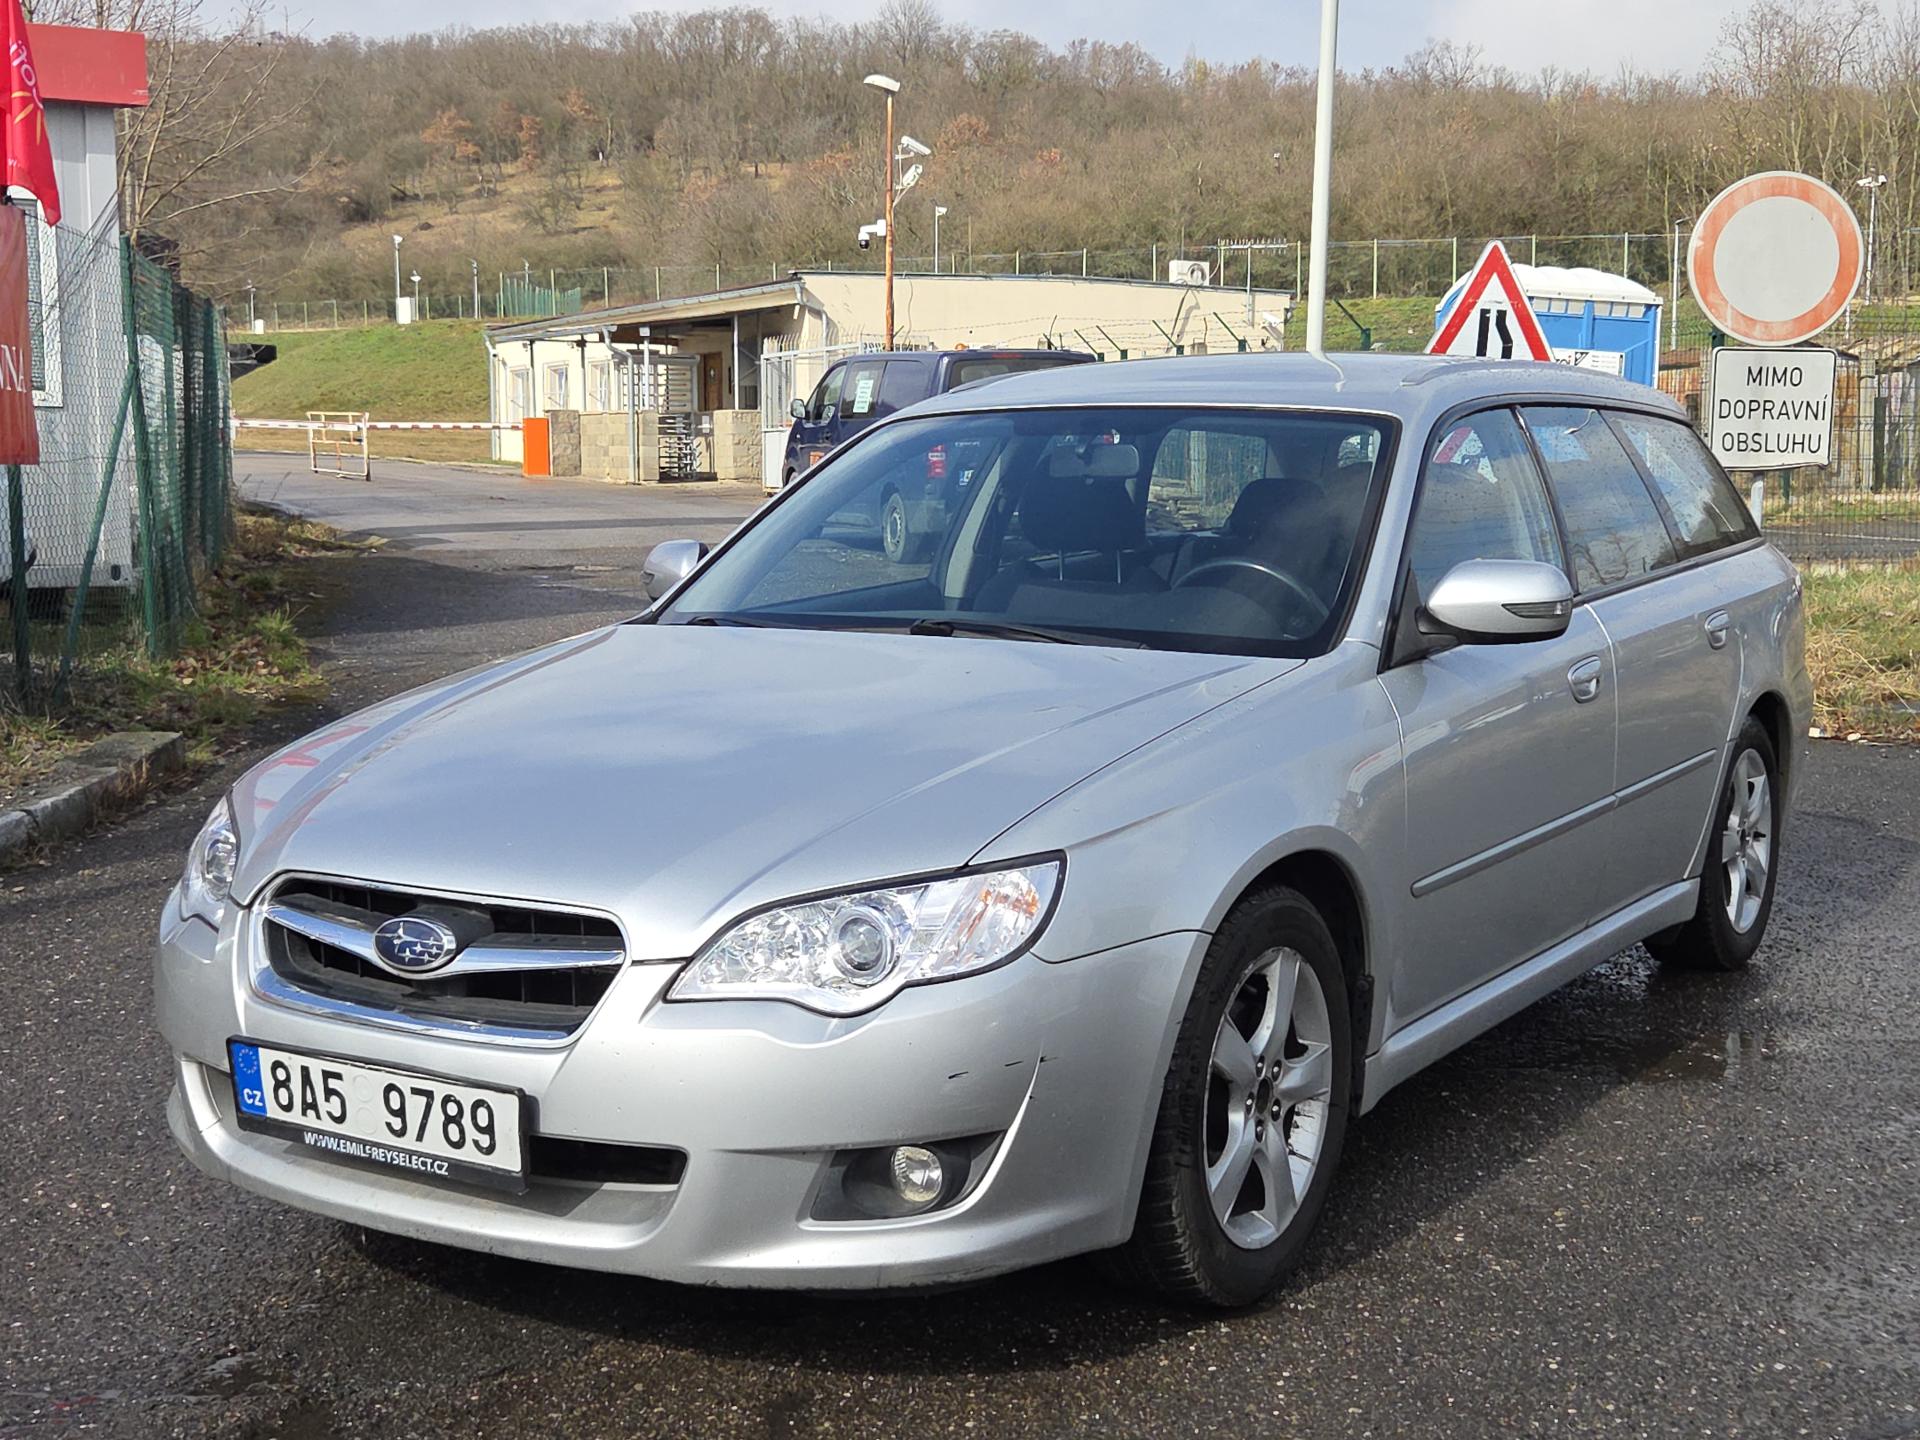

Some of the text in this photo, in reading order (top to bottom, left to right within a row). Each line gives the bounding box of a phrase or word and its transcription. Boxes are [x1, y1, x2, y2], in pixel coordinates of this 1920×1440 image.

[1746, 366, 1803, 387] MIMO
[1718, 394, 1828, 421] DOPRAVNÍ
[1721, 432, 1822, 454] OBSLUHU
[243, 1088, 263, 1107] CZ
[270, 1060, 496, 1156] 8A5 9789
